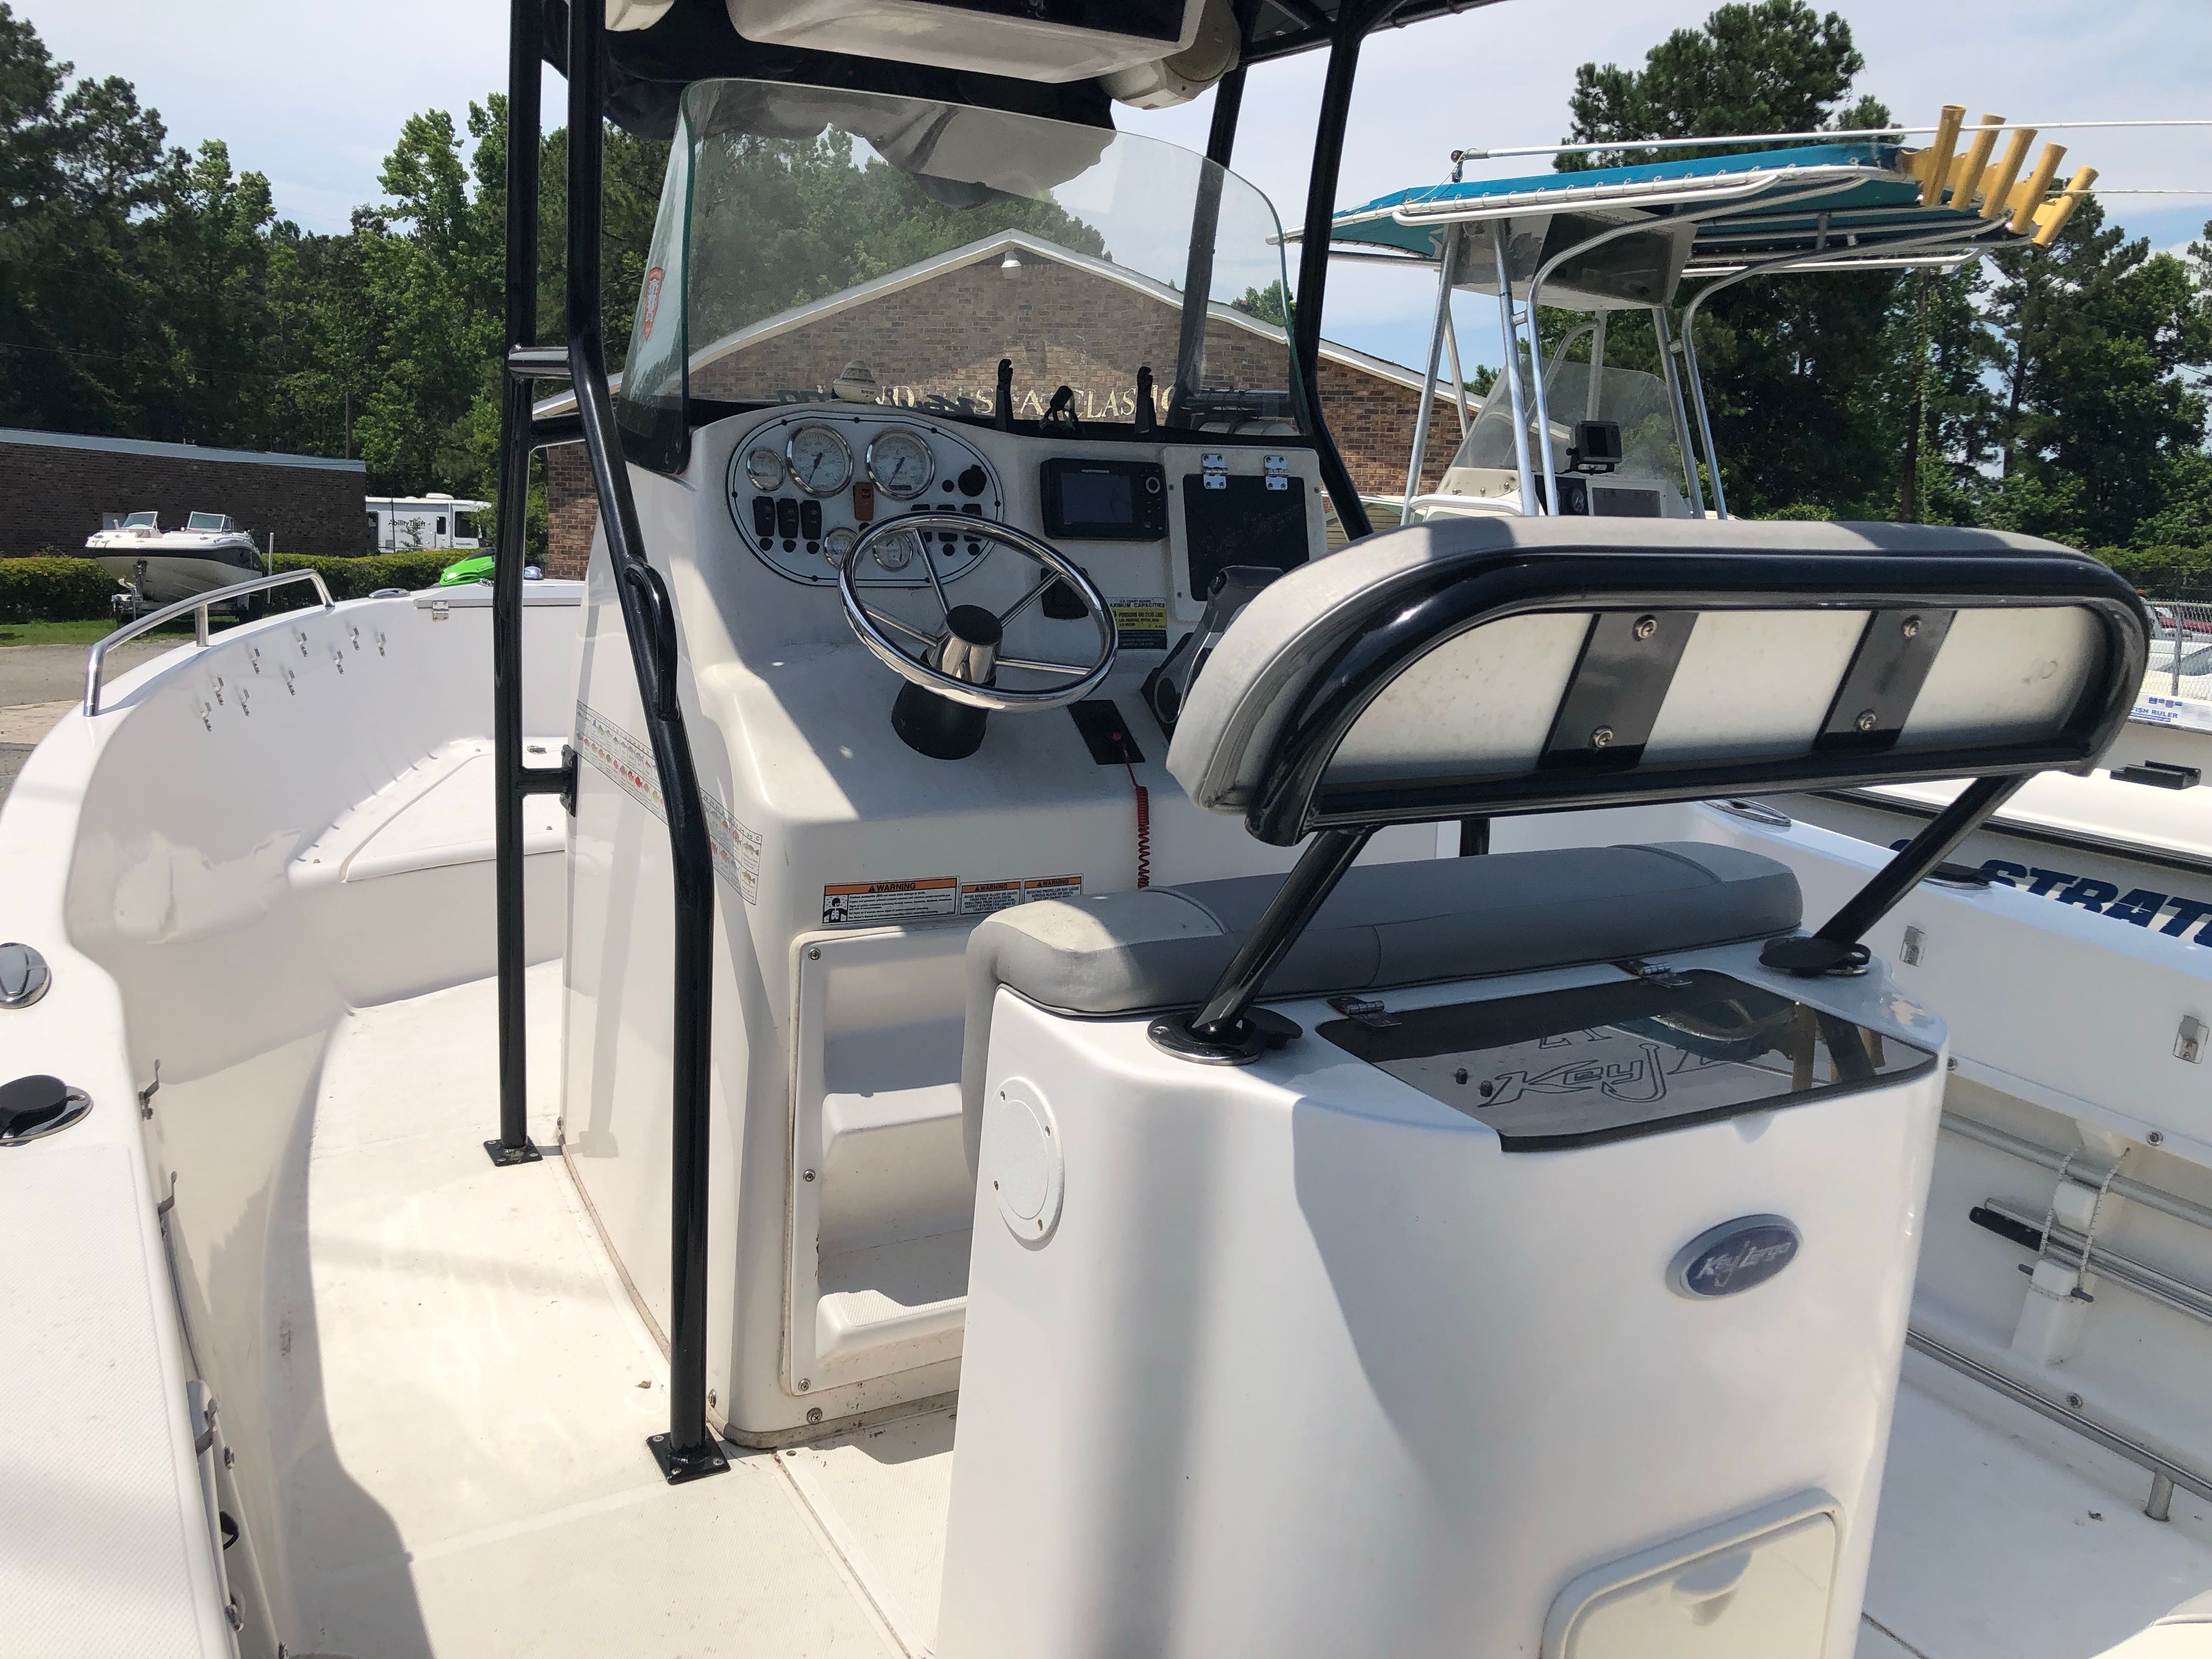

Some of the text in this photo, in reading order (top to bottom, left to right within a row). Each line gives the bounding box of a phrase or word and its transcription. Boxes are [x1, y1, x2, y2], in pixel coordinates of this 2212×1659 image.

[975, 388, 1045, 415] SA
[2151, 710, 2178, 718] RULER
[877, 882, 916, 891] WARNING
